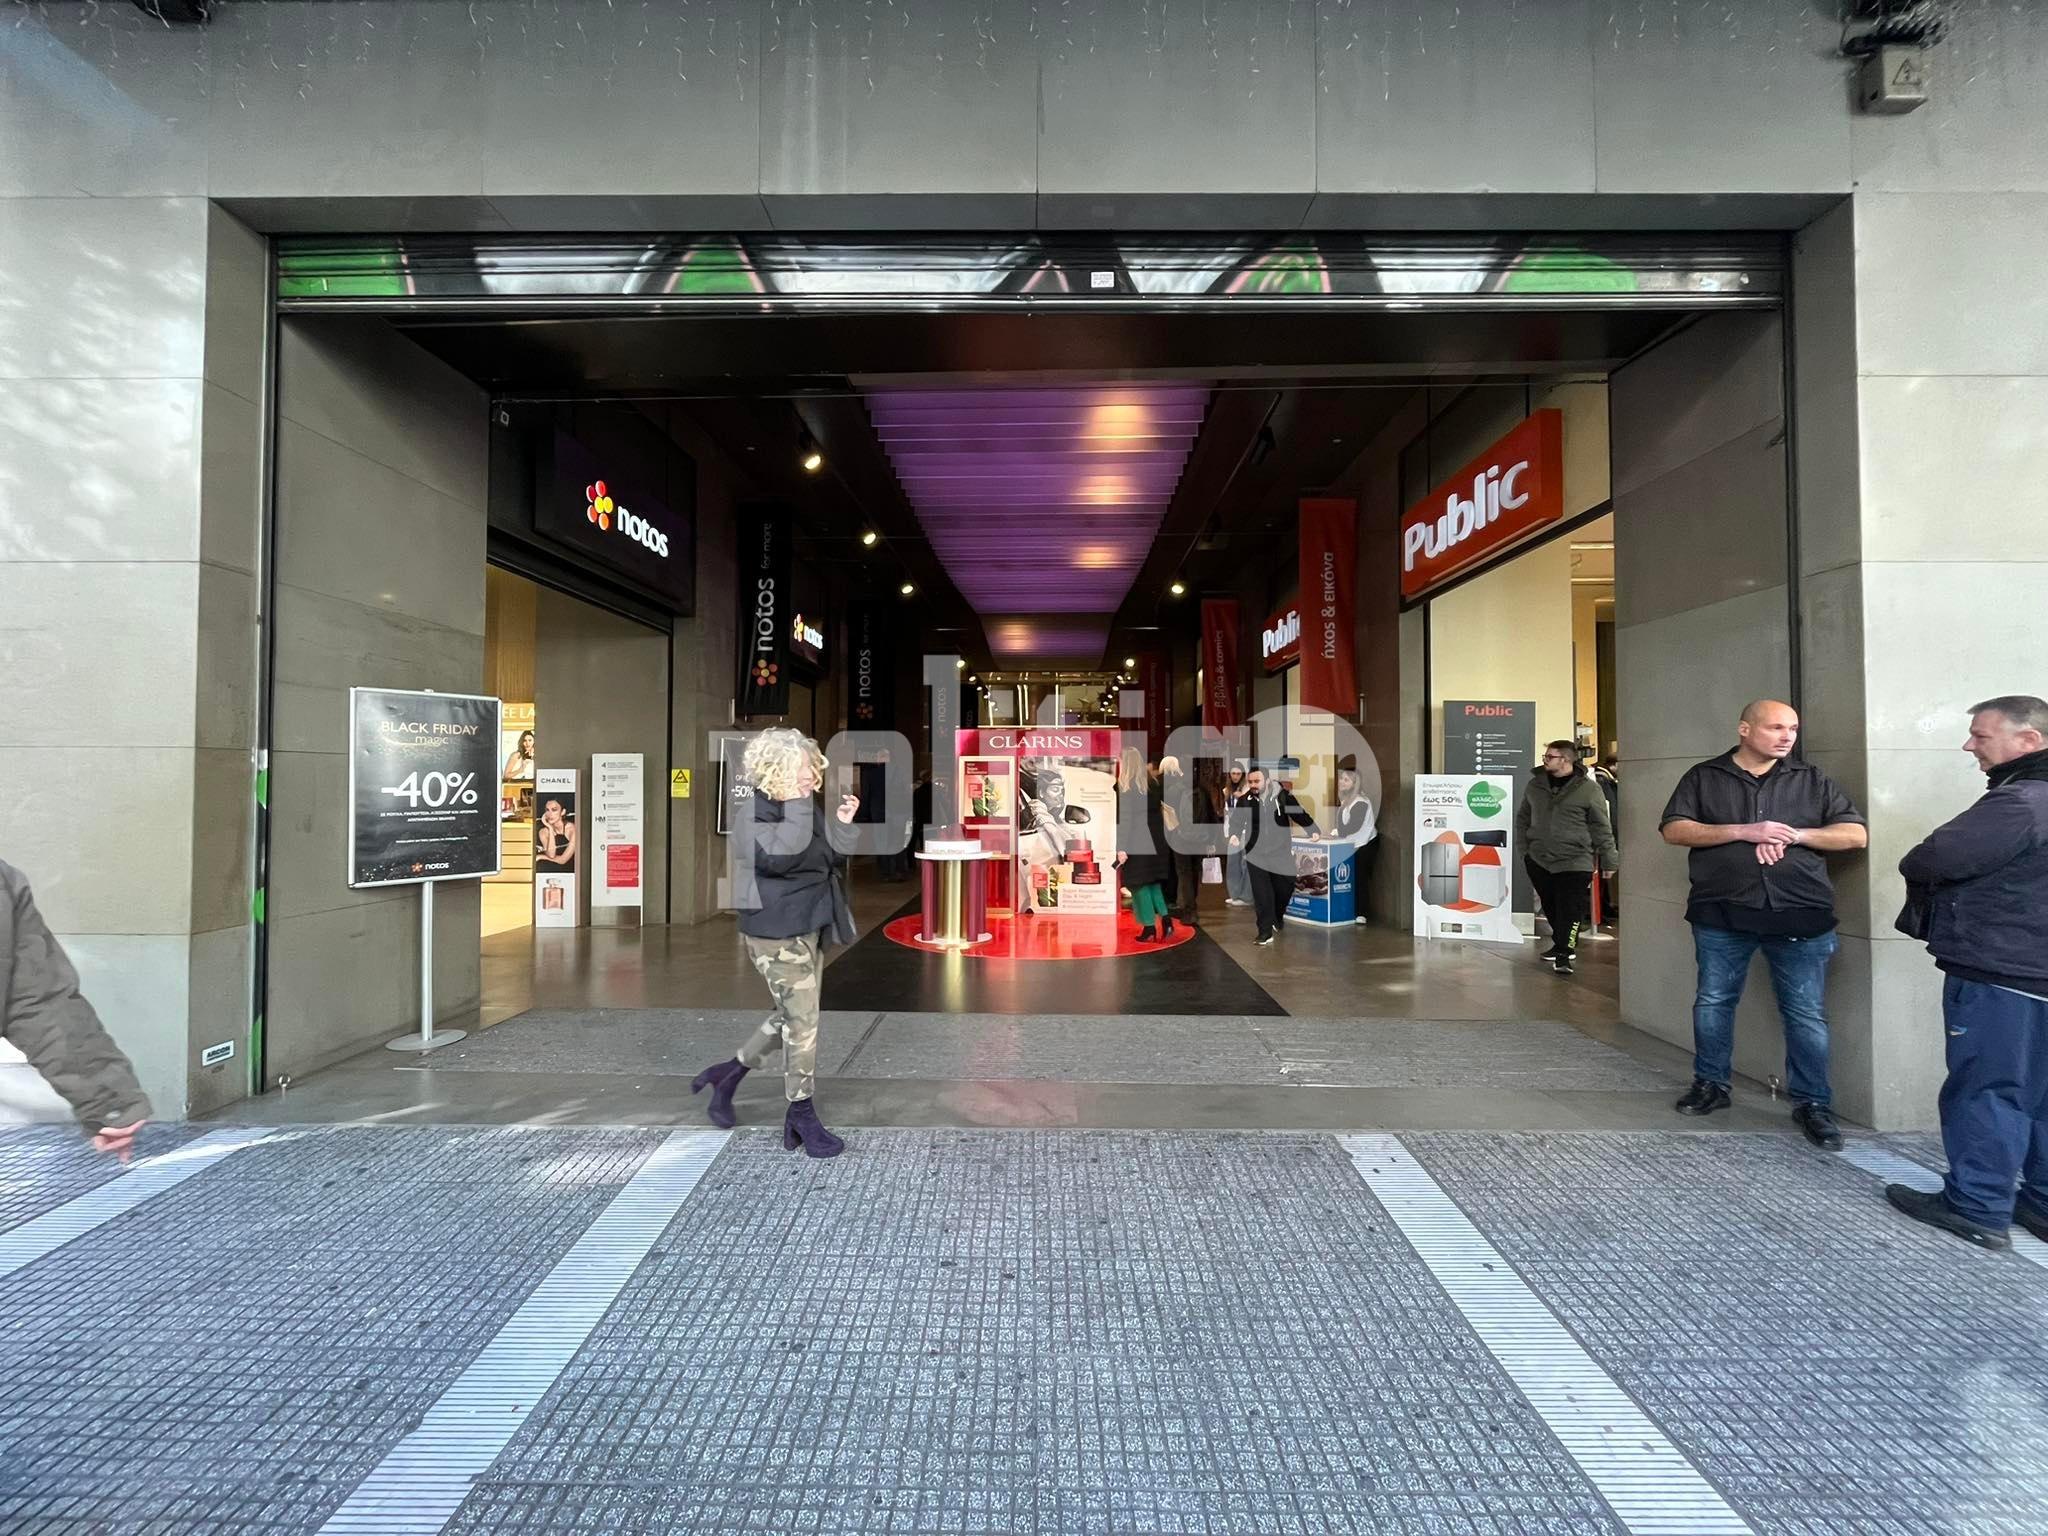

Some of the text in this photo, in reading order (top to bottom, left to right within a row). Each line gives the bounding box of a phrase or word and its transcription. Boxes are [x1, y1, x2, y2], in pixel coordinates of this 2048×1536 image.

[1404, 460, 1529, 572] Public
[617, 505, 669, 558] notos
[1320, 552, 1336, 602] εικόνα
[757, 578, 775, 651] notos
[1321, 606, 1336, 618] &
[803, 625, 824, 650] notos
[858, 649, 871, 697] notos
[1464, 705, 1514, 716] Public
[382, 721, 479, 736] BLACK FRIDAY
[415, 735, 449, 748] magic
[989, 735, 1083, 749] CLARINS
[381, 771, 478, 808] -40%
[731, 786, 755, 797] -50%
[425, 862, 450, 870] notos
